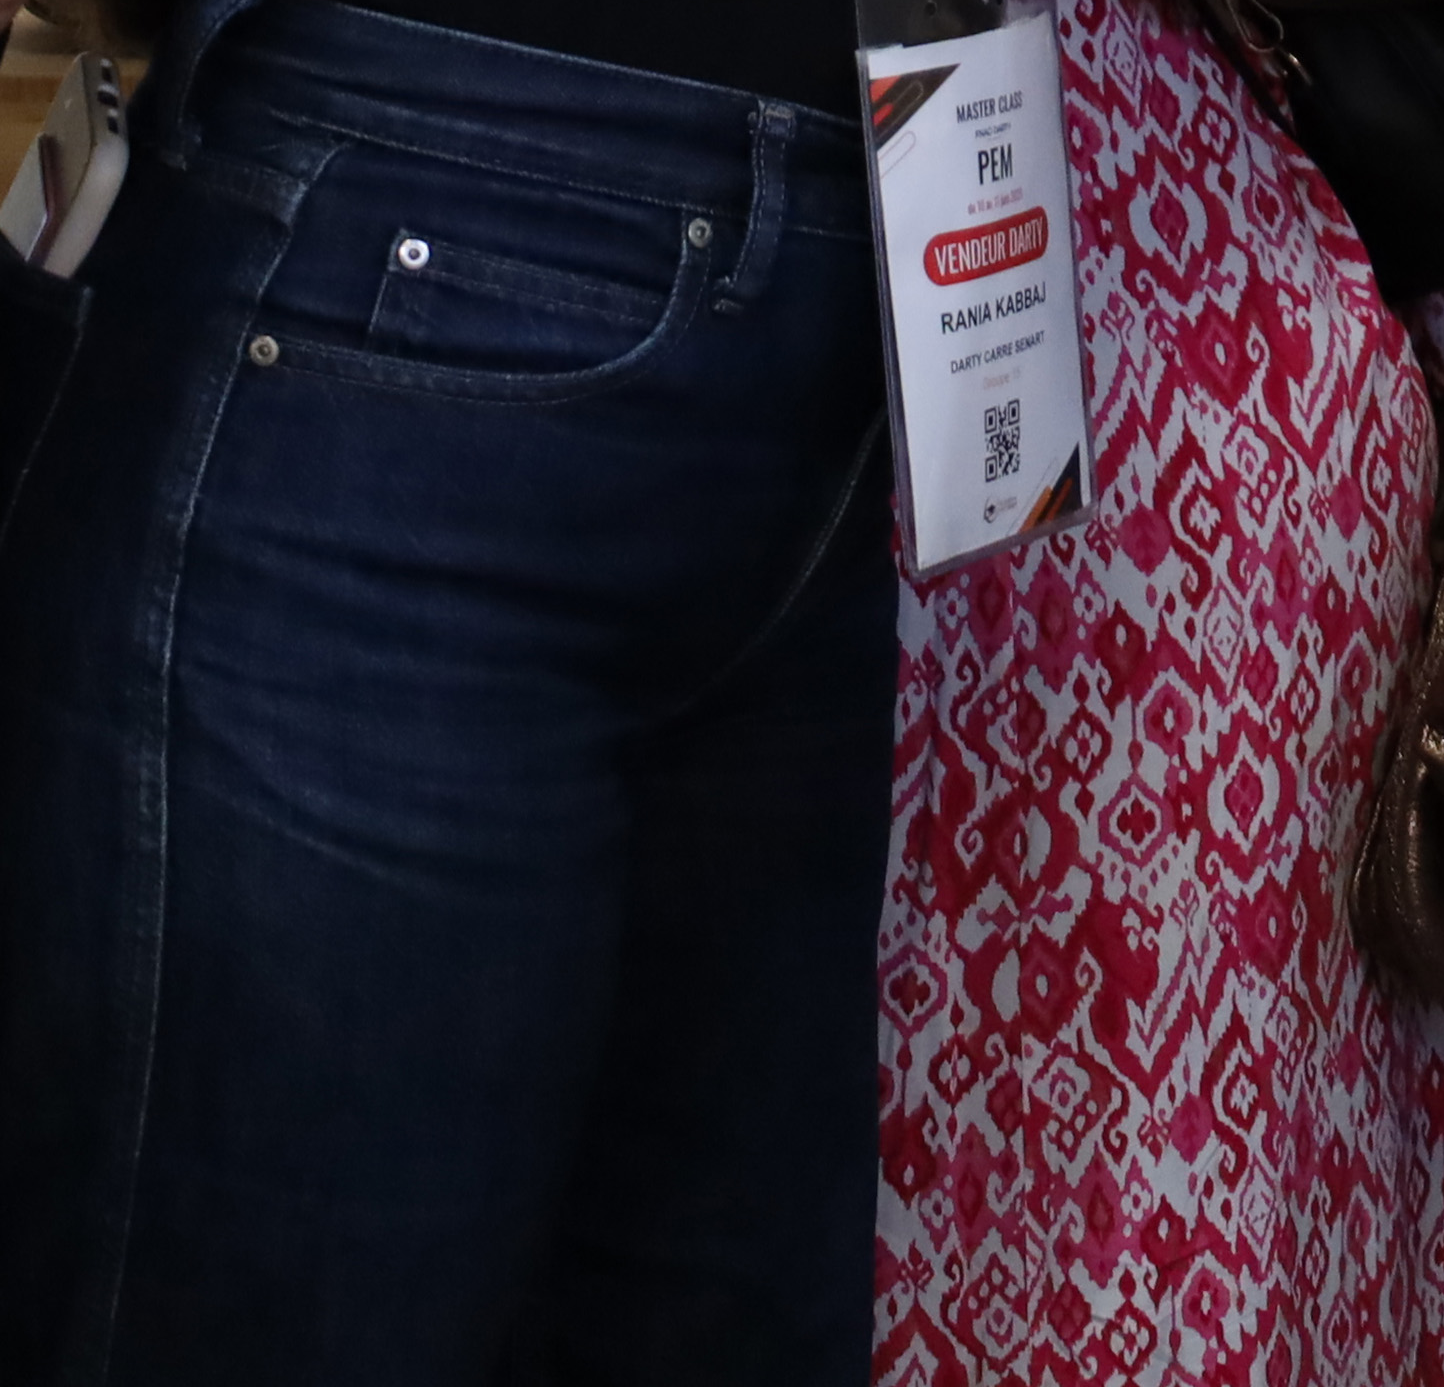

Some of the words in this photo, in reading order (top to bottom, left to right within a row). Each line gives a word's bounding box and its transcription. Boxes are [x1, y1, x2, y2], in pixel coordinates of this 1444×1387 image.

[956, 98, 995, 123] MASTER
[998, 90, 1023, 114] CLASS
[978, 143, 1013, 185] PEM
[934, 231, 1006, 276] VENDEUR
[1009, 217, 1043, 257] DARTY
[941, 301, 992, 335] RANIA
[995, 281, 1046, 320] KABBAJ
[951, 352, 982, 374] DARTY
[984, 342, 1013, 364] CARRE
[1015, 330, 1045, 353] SENART
